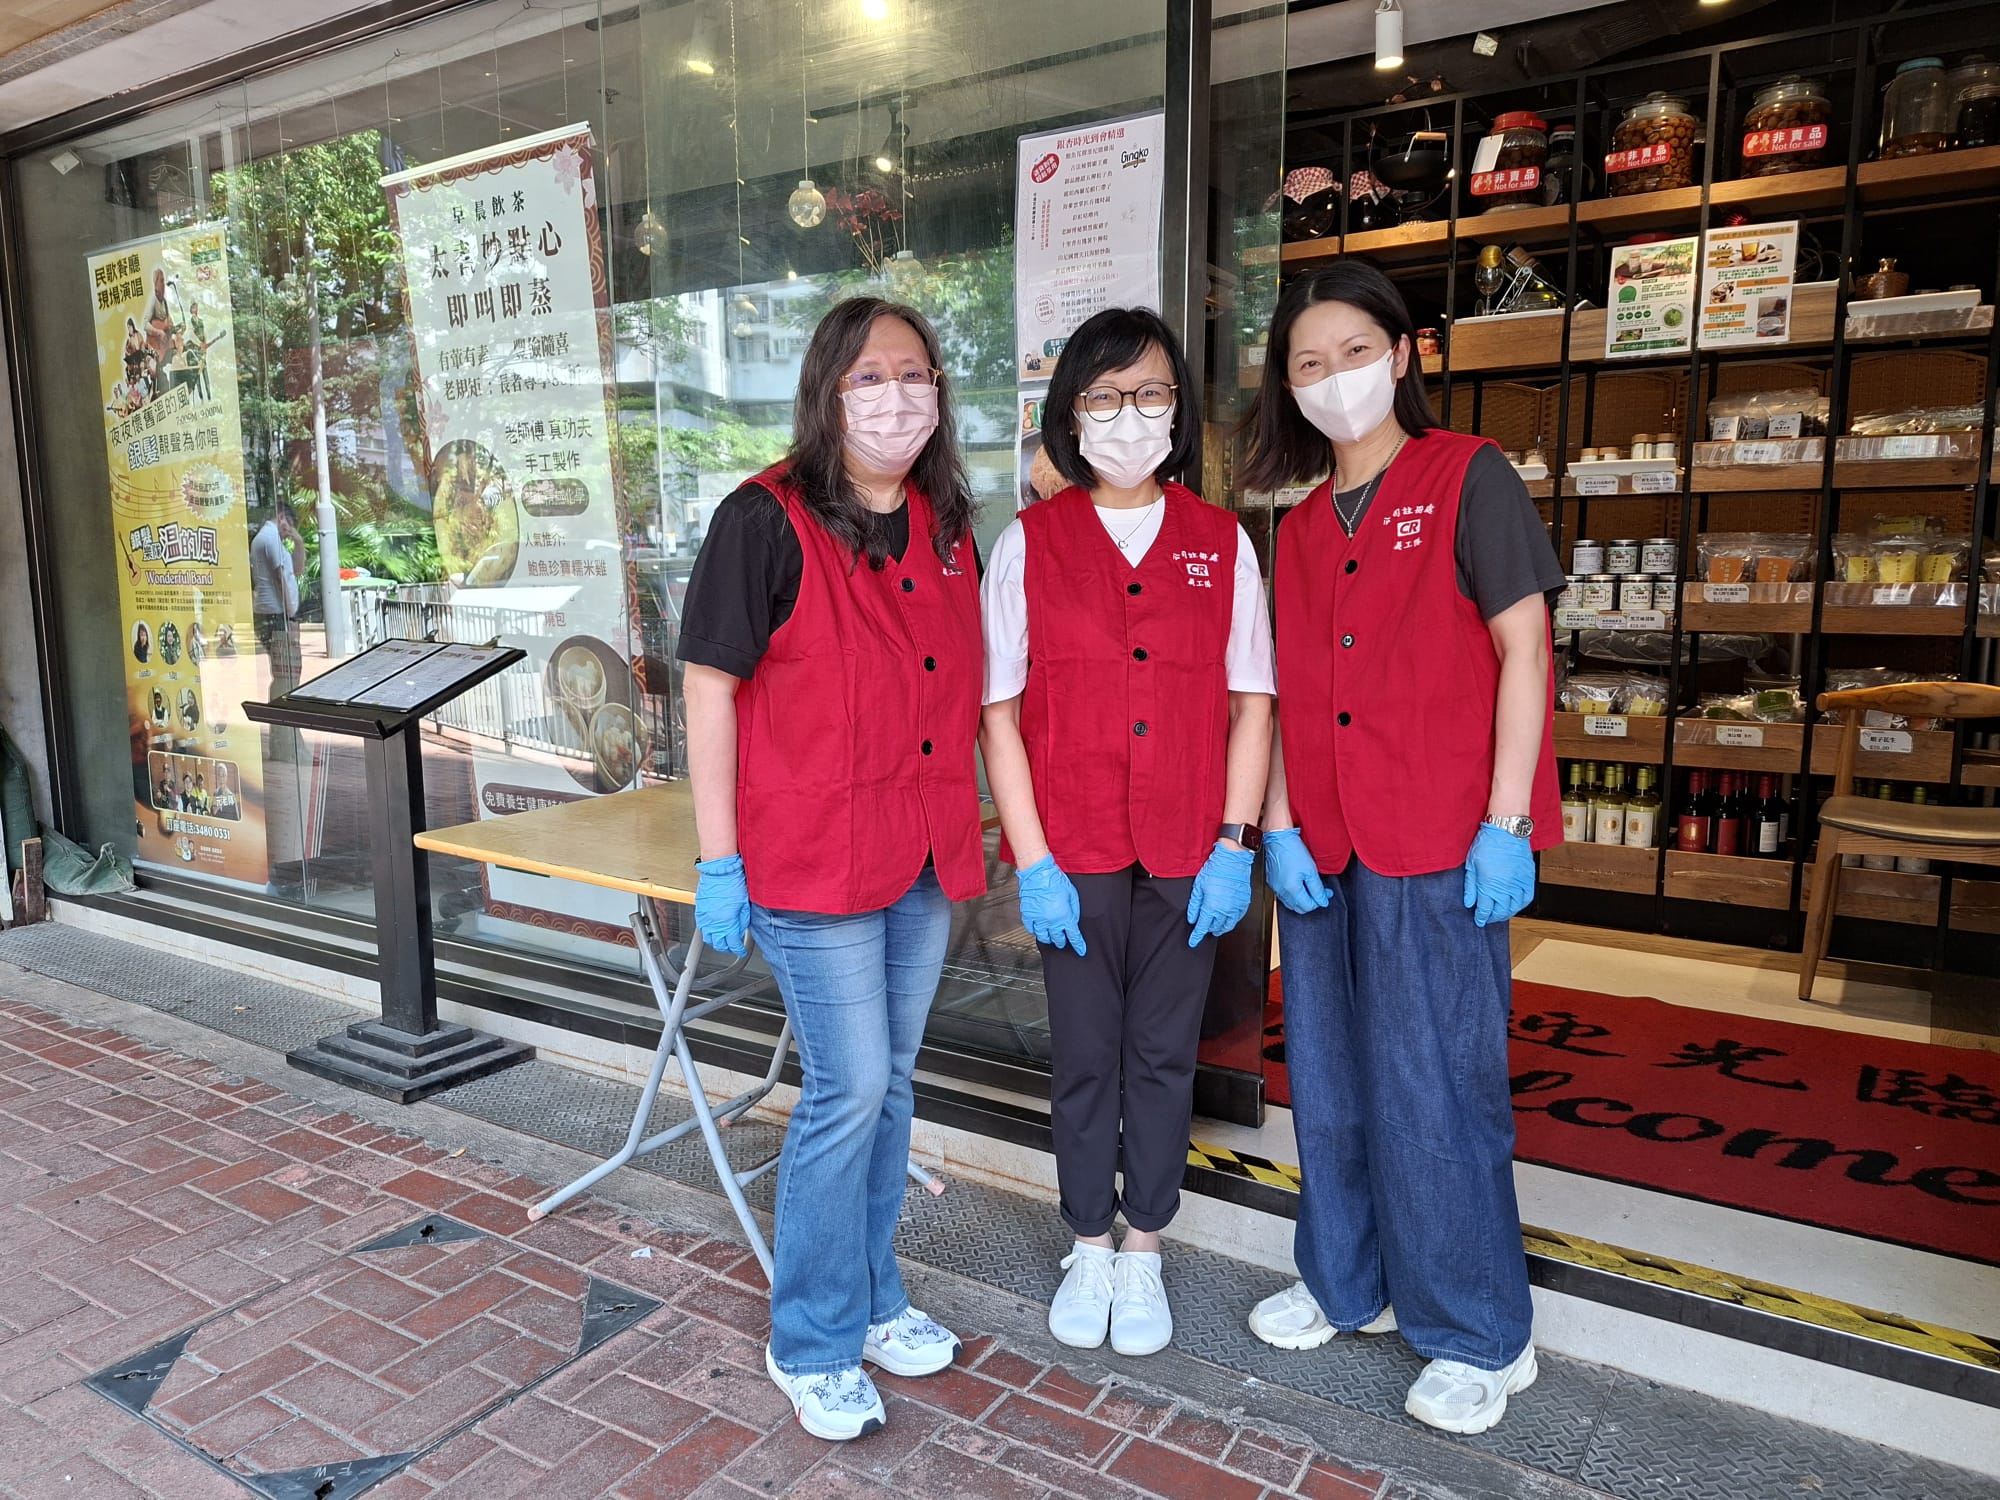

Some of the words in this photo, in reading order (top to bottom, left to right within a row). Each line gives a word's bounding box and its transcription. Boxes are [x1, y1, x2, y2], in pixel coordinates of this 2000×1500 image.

[1772, 126, 1822, 143] 非賣品
[1627, 145, 1667, 160] 非賣品
[1772, 143, 1787, 151] Not
[1789, 140, 1800, 149] for
[1803, 139, 1821, 147] sale
[1121, 148, 1149, 168] Gingko
[1627, 159, 1640, 167] Not
[1641, 156, 1651, 164] for
[1494, 168, 1536, 183] 非賣品
[1494, 182, 1507, 190] Not
[1508, 181, 1519, 189] for
[1519, 179, 1534, 188] sale
[453, 190, 525, 224] 早晨飲茶
[95, 254, 141, 288] 民歌餐廳
[97, 276, 144, 310] 現場演唱
[447, 278, 553, 328] 即叫即蒸
[438, 344, 489, 372] 有葷有素
[504, 421, 546, 444] 老師傅
[548, 417, 593, 440] 真功夫
[525, 450, 581, 473] 手工製作
[1399, 521, 1419, 534] CR
[527, 559, 608, 576] 鮑魚珍寶糯米雞
[1189, 564, 1206, 575] CR
[145, 569, 190, 586] Wonderful
[191, 569, 214, 586] Band
[485, 790, 566, 811] 免費養生健康
[213, 827, 231, 840] 0331
